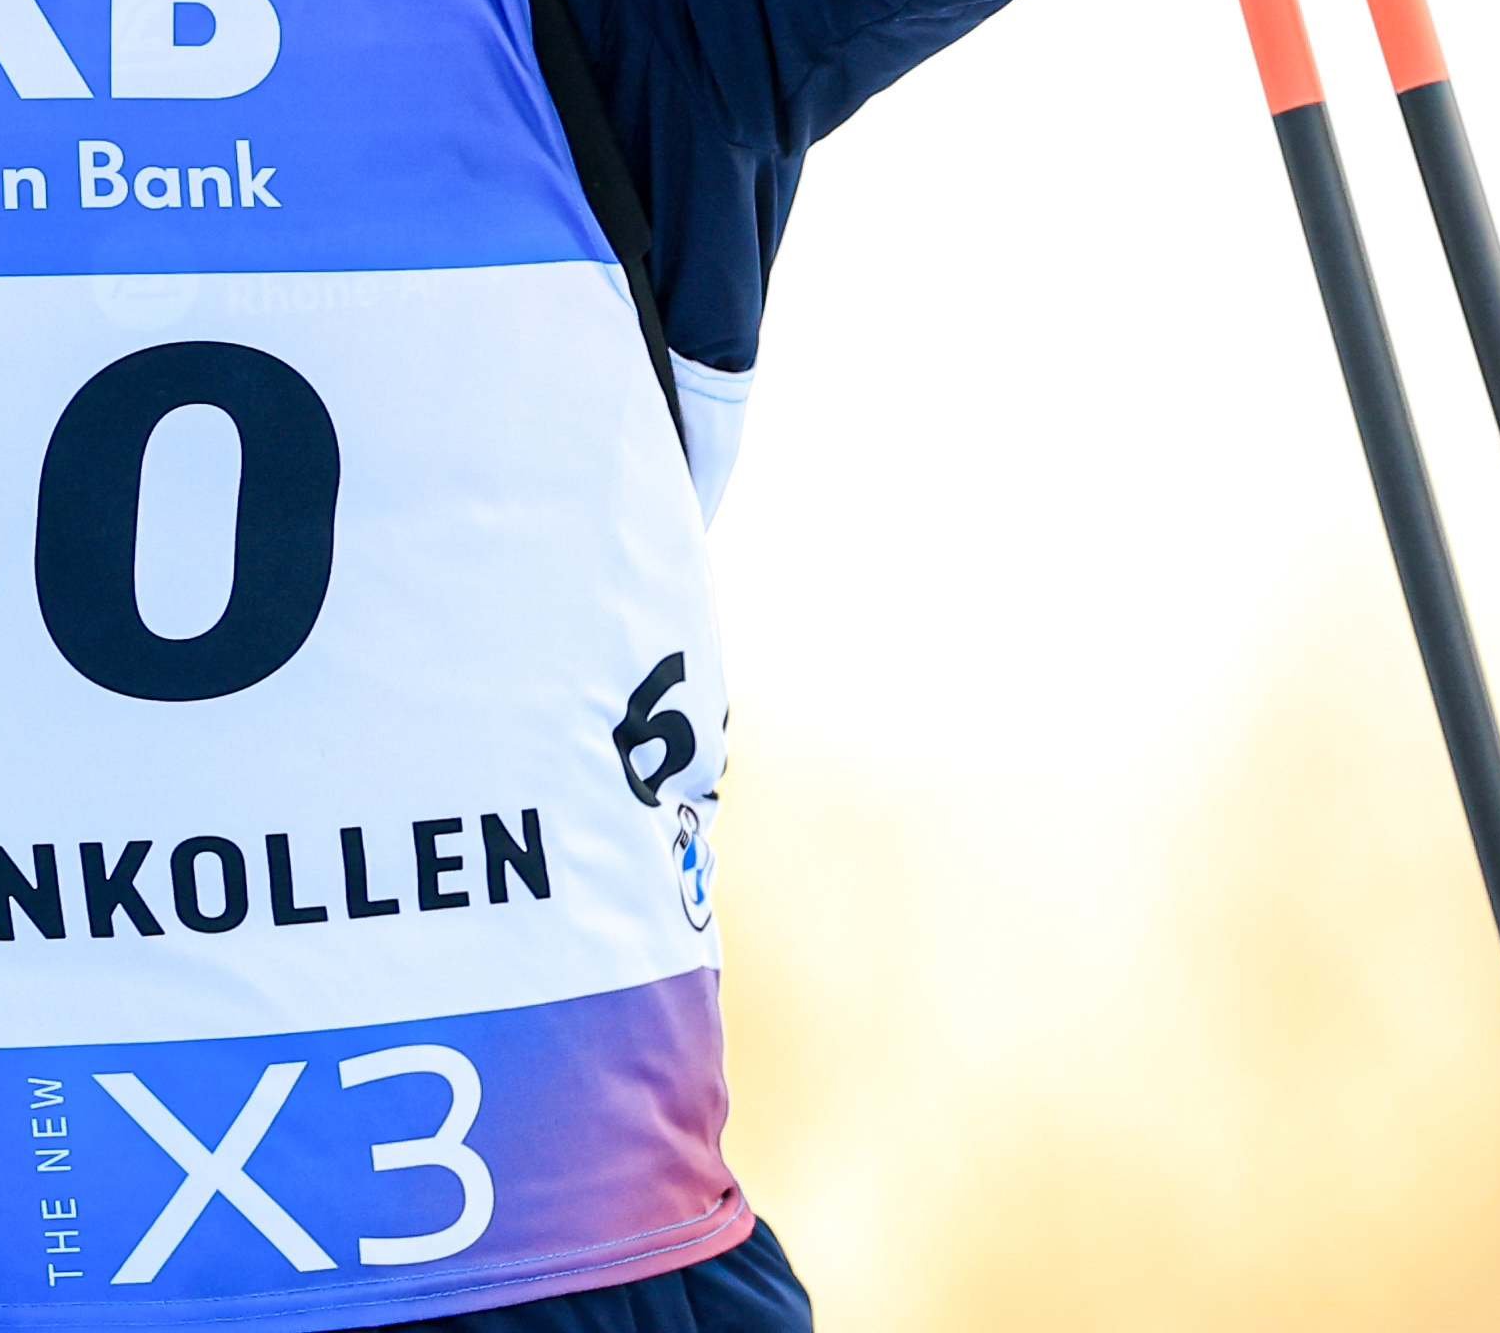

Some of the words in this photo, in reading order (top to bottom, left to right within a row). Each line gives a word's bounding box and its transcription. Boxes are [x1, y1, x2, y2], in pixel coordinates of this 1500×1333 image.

[77, 139, 283, 211] Bank
[29, 1074, 69, 1177] NEW
[92, 1043, 497, 1287] X3
[47, 1196, 81, 1288] THE
